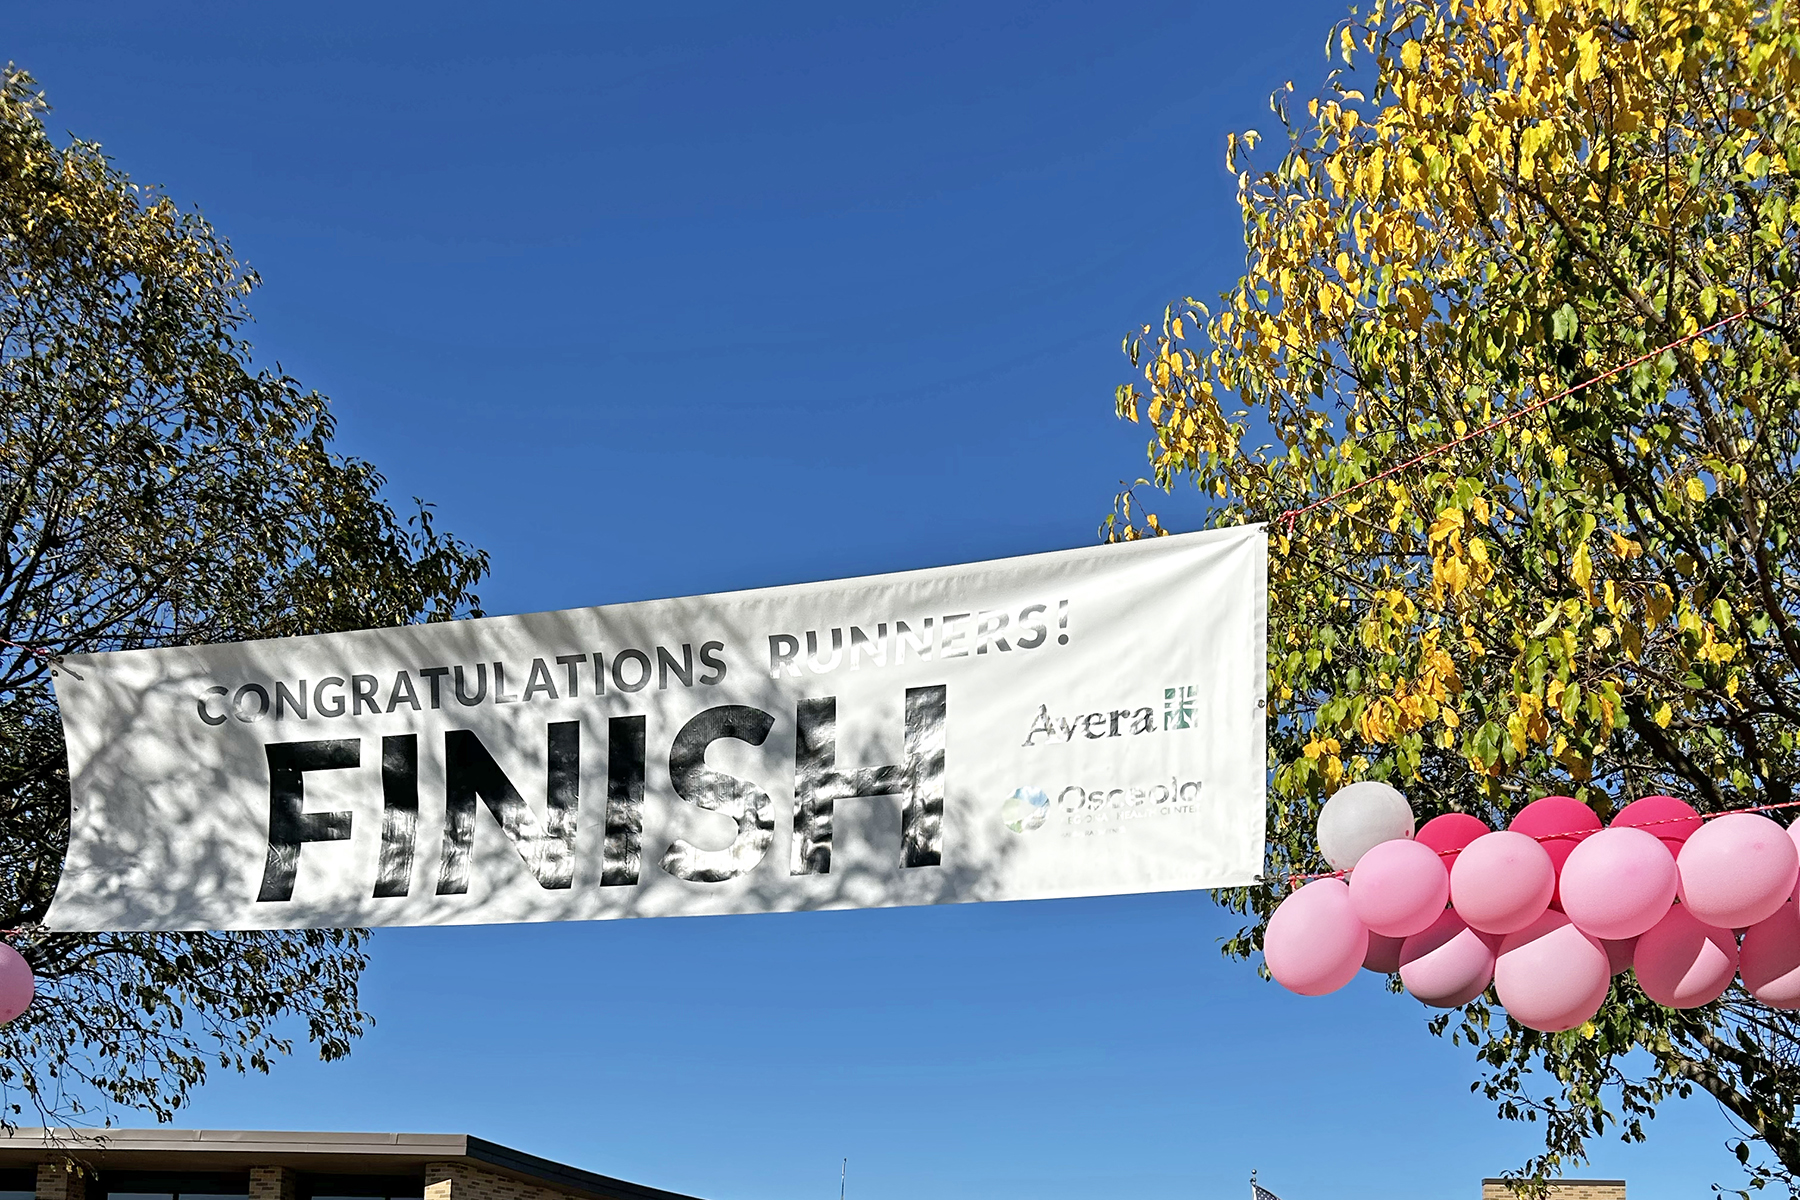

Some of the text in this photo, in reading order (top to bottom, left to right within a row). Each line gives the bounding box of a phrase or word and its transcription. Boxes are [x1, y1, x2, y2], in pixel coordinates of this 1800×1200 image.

[197, 599, 1070, 726] CONGRATULATIONS RUNNERS!
[1021, 703, 1158, 747] Avera
[256, 684, 948, 903] FINISH
[1057, 776, 1202, 813] Osceola
